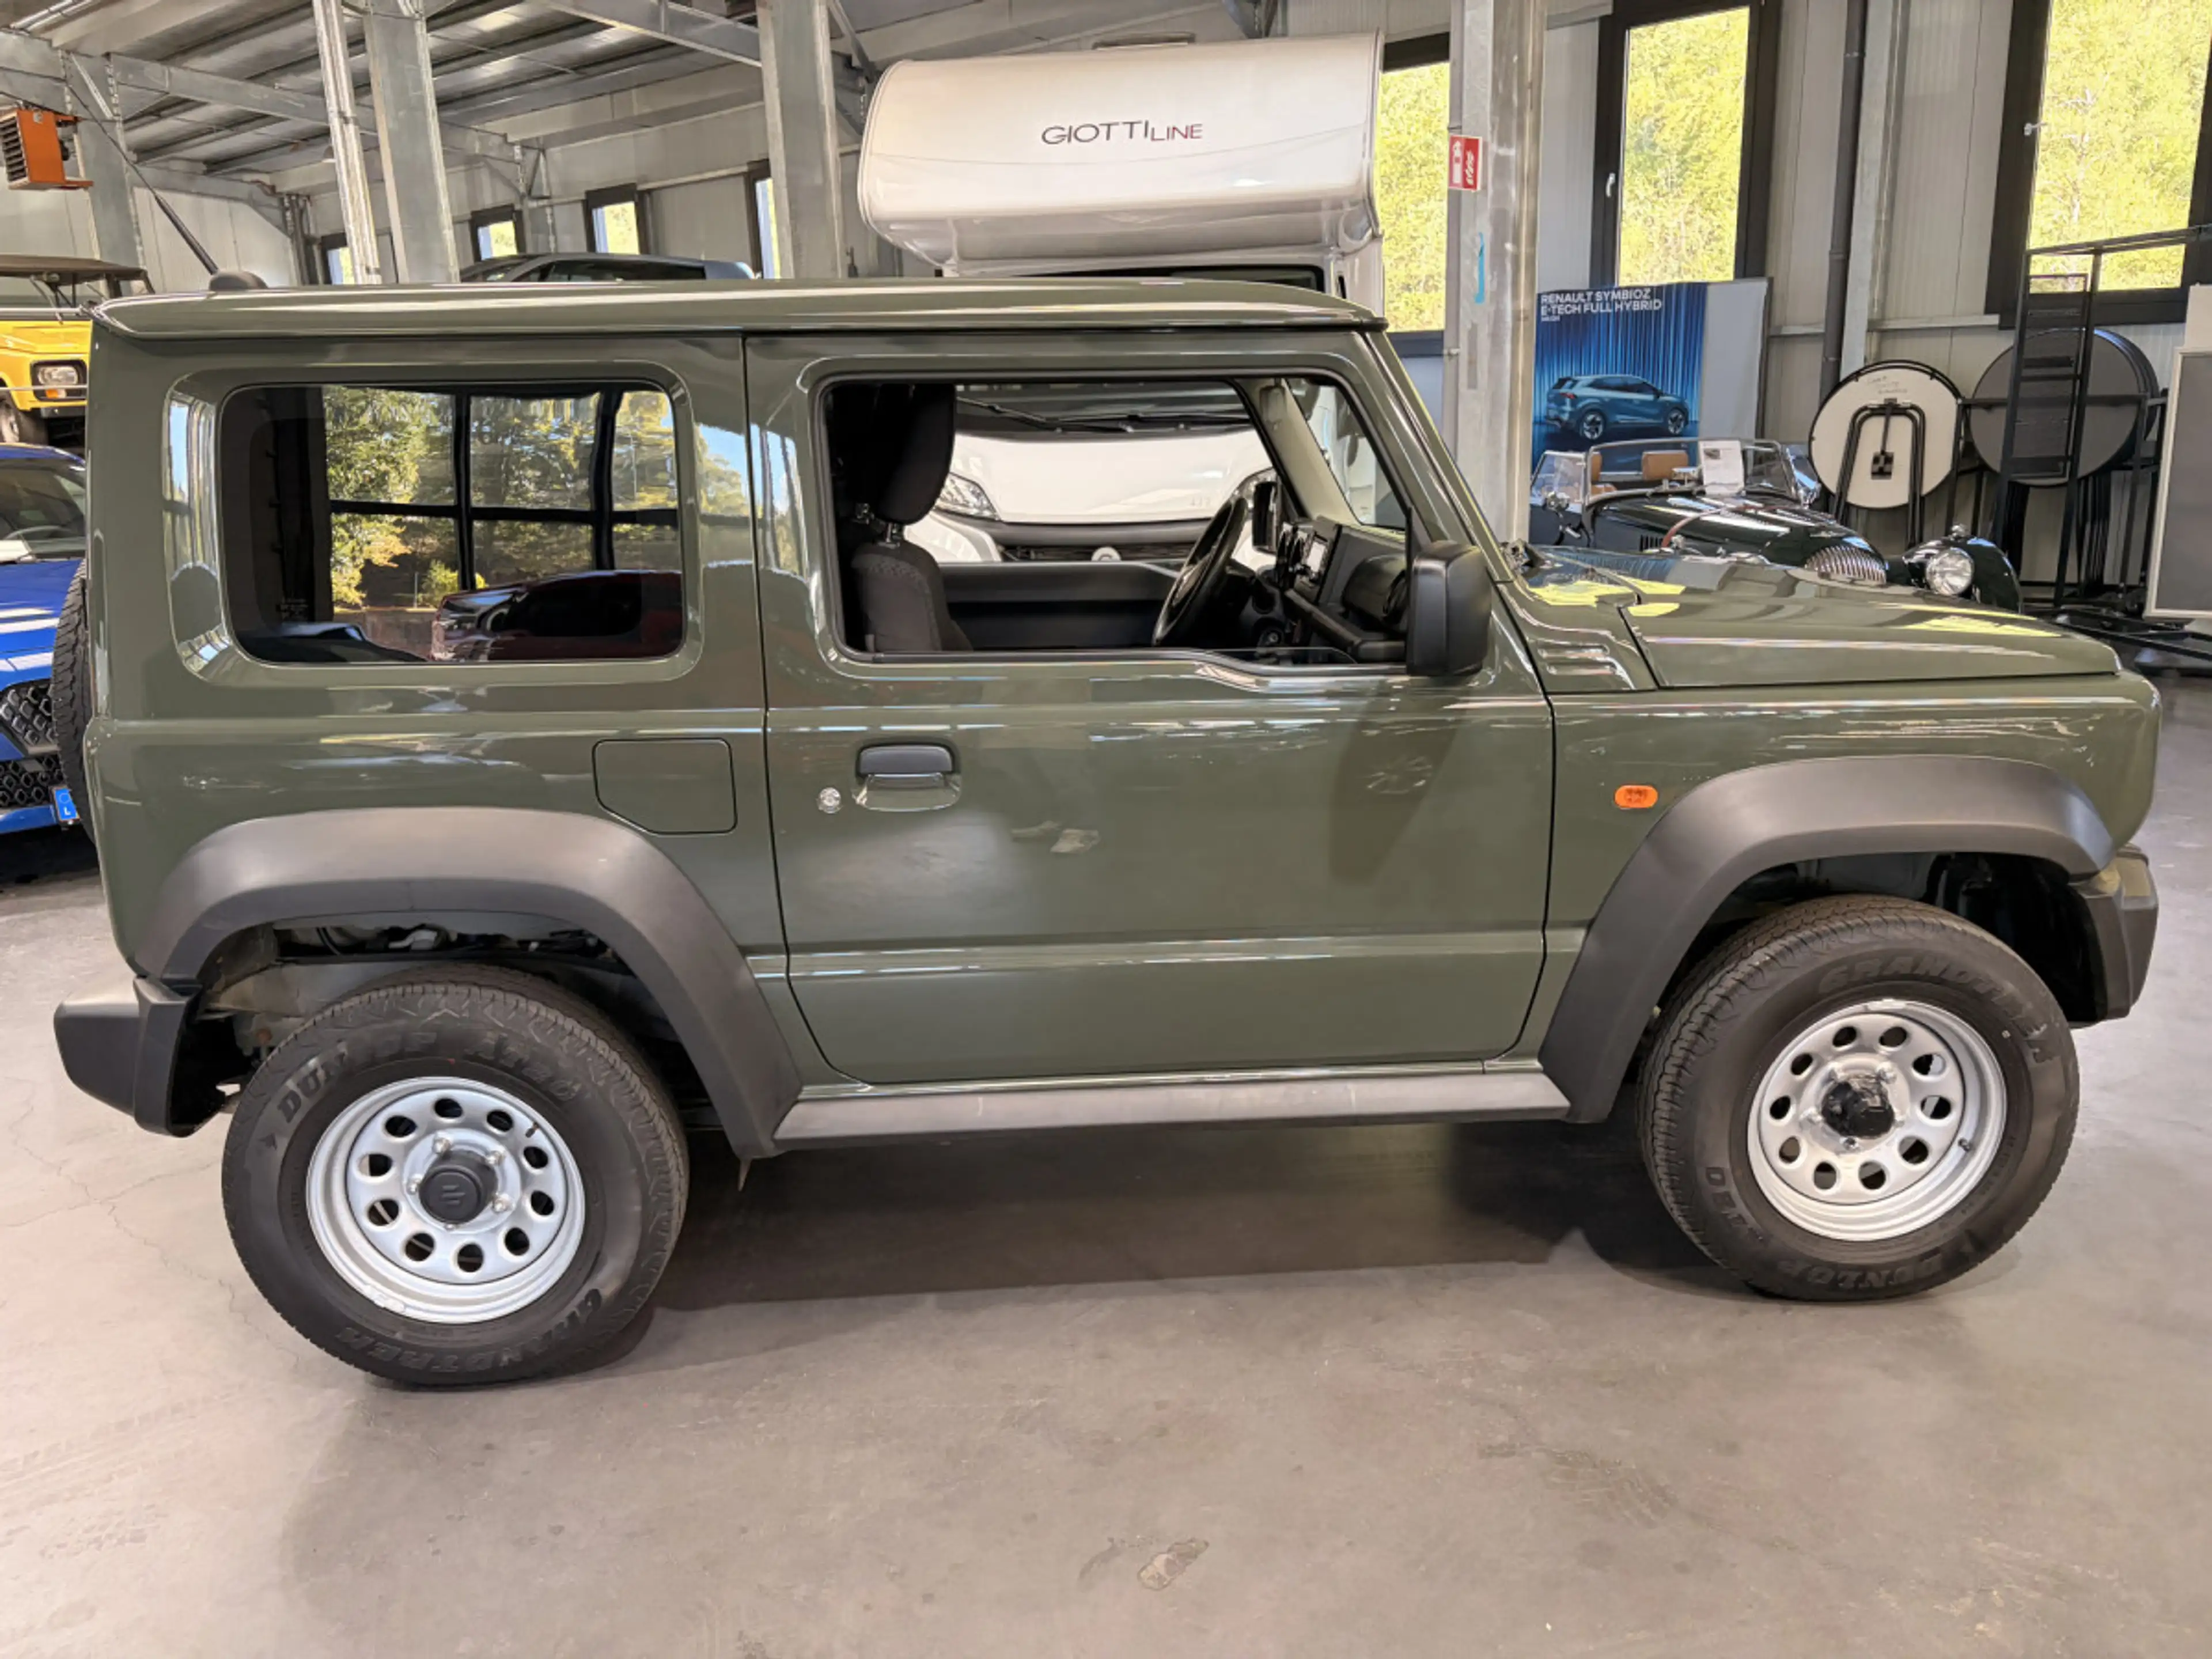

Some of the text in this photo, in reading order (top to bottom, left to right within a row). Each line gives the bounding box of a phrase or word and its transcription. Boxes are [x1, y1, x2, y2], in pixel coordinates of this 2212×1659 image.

[1041, 120, 1203, 145] GIOTTILINE
[1541, 287, 1650, 304] RENAULT SYMBIOZ
[1584, 302, 1612, 313] FULL
[1615, 298, 1662, 312] HYBRID
[278, 1032, 437, 1123] DUNOP
